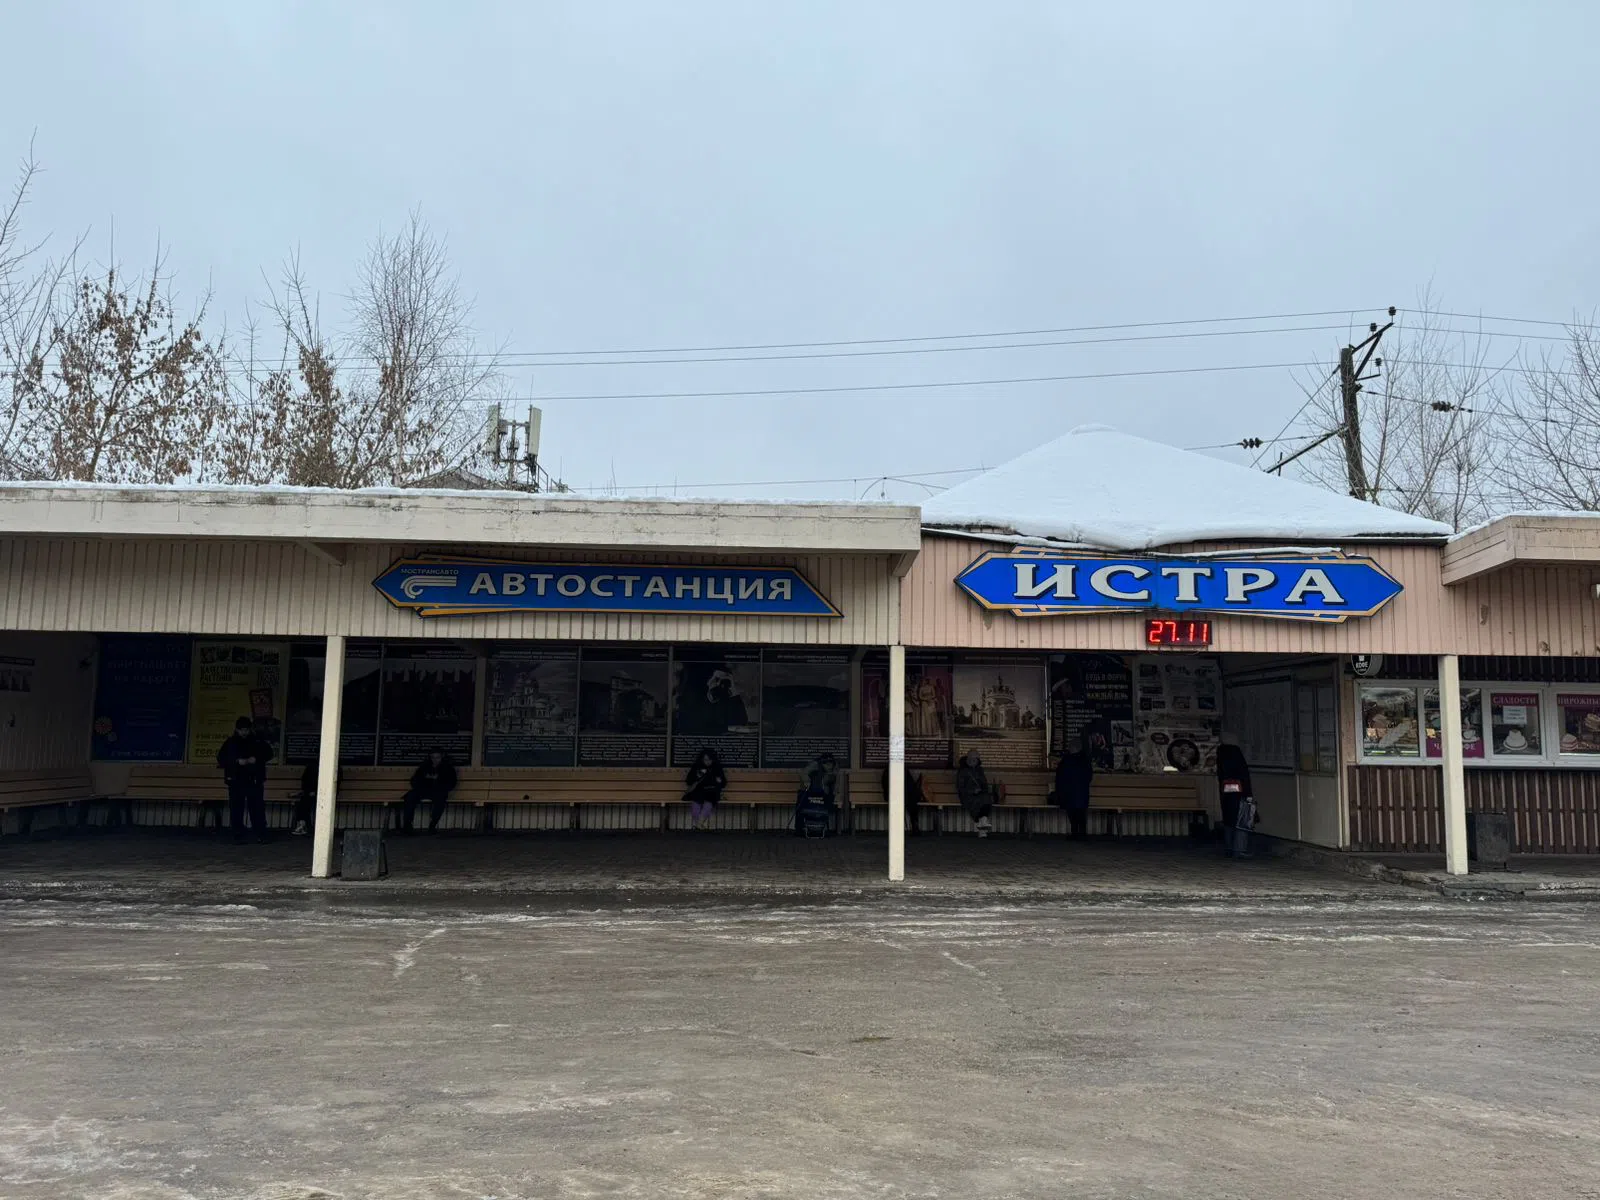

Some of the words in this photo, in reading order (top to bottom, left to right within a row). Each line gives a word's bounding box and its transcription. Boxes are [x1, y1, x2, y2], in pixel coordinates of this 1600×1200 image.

[468, 572, 793, 605] АВТОСТАНЦИЯ
[1013, 563, 1347, 605] ИСТРА
[1150, 620, 1208, 644] 27.11
[1492, 695, 1537, 705] СЛАДОСТИ
[1558, 695, 1600, 705] ПИРОЖНЫ
